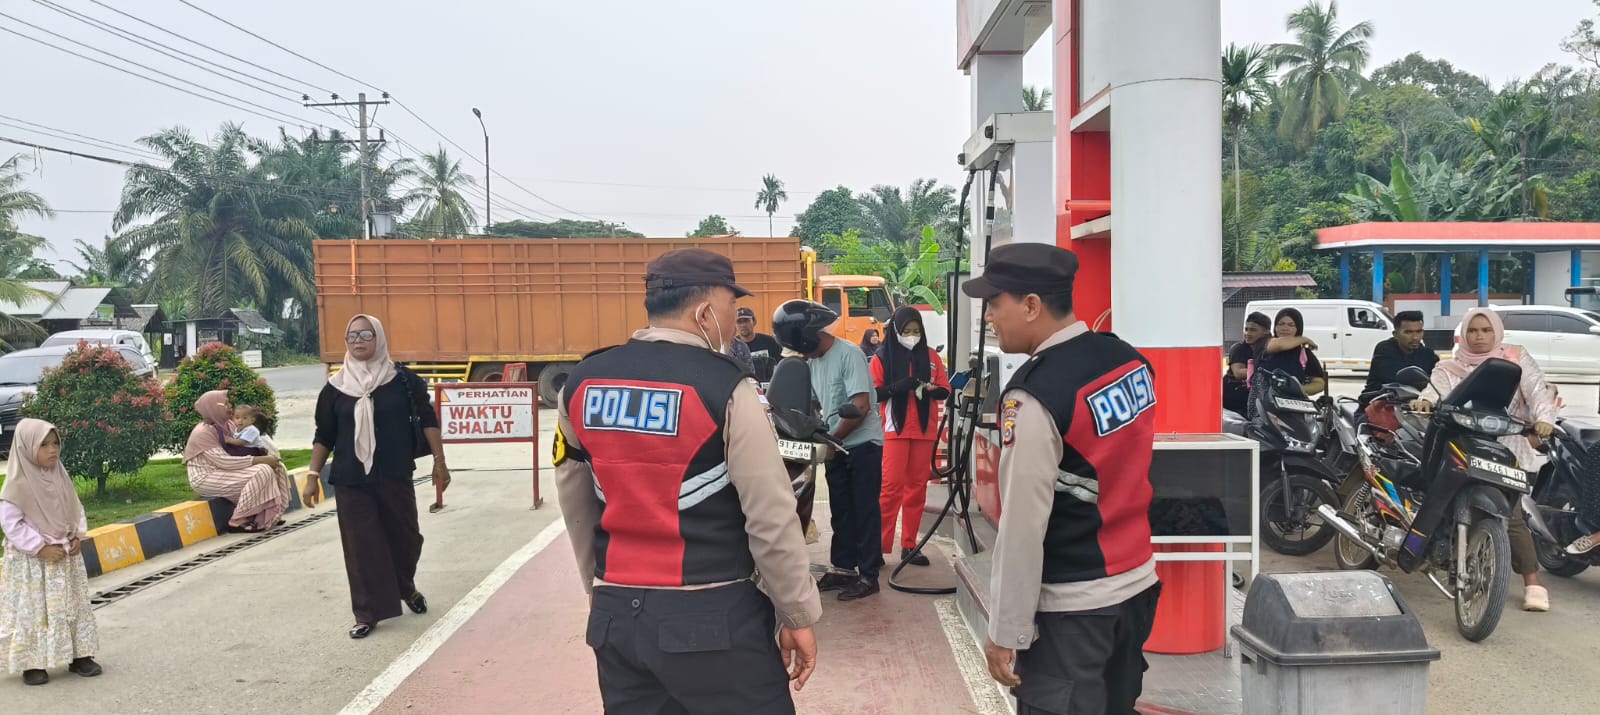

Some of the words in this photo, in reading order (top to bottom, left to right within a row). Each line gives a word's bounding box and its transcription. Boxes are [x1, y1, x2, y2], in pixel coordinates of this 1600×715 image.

[457, 390, 528, 398] PERHATIAN
[449, 405, 512, 420] WAKTU
[586, 389, 676, 431] POLISI
[447, 421, 514, 434] SHALAT
[792, 442, 810, 450] FAM
